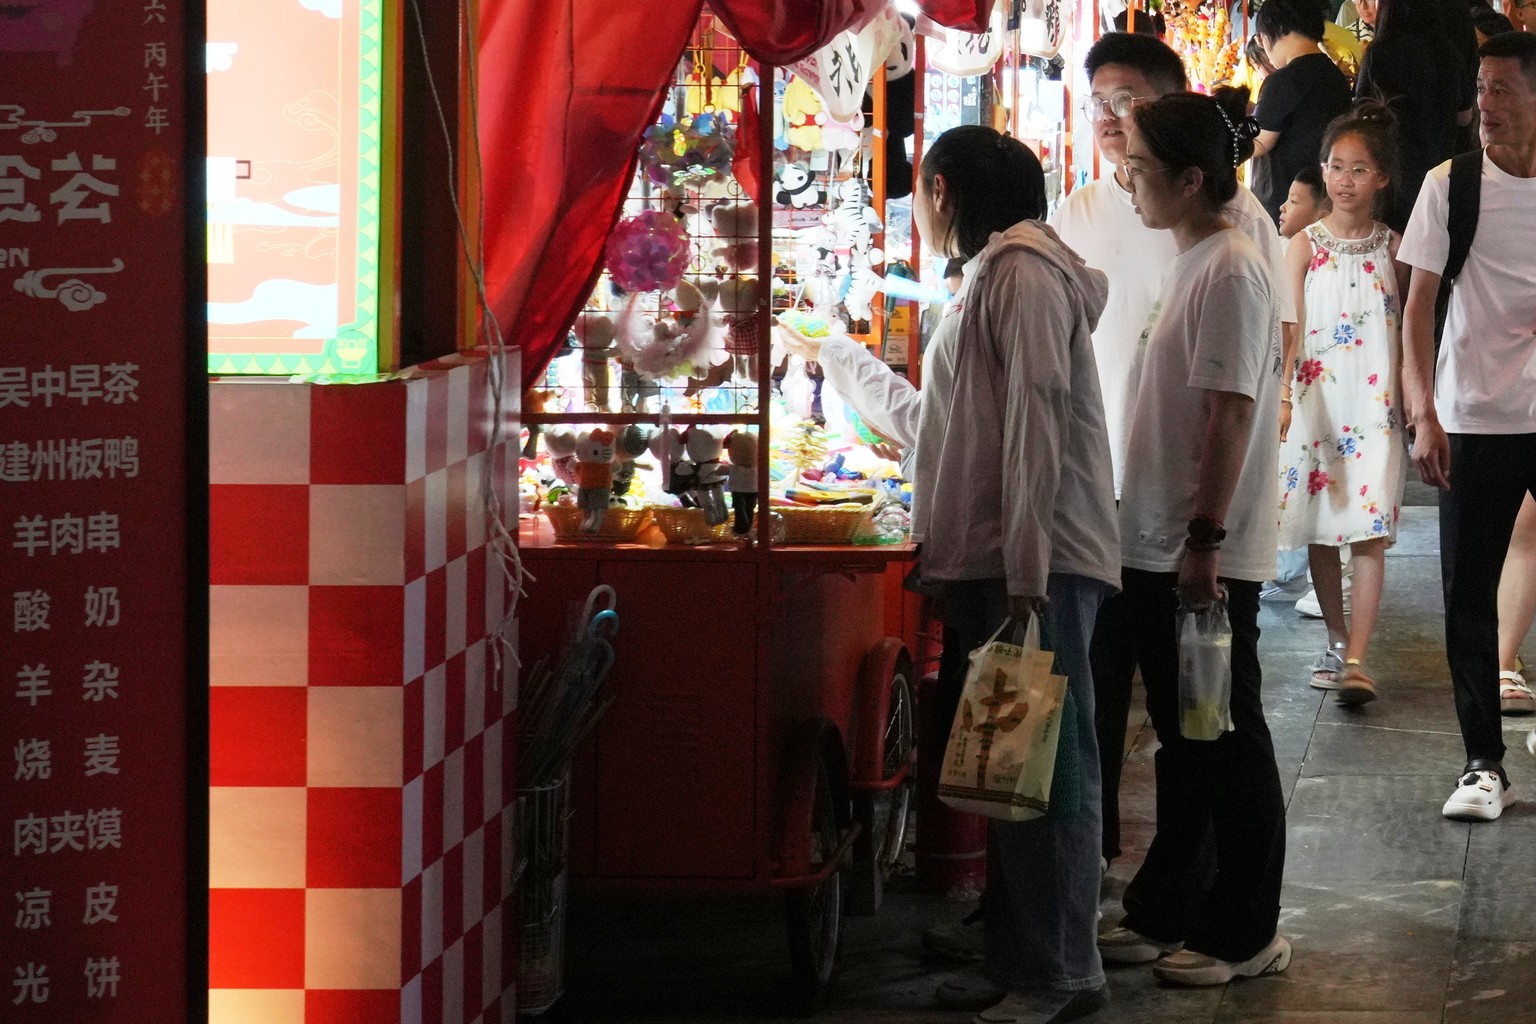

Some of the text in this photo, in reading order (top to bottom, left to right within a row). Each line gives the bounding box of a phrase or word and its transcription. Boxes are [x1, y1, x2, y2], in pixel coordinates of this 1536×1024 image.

[143, 42, 170, 135] 丙午年
[0, 435, 140, 483] 建州板鸭
[13, 512, 121, 557] 羊肉串
[13, 807, 122, 857] 肉夹馍
